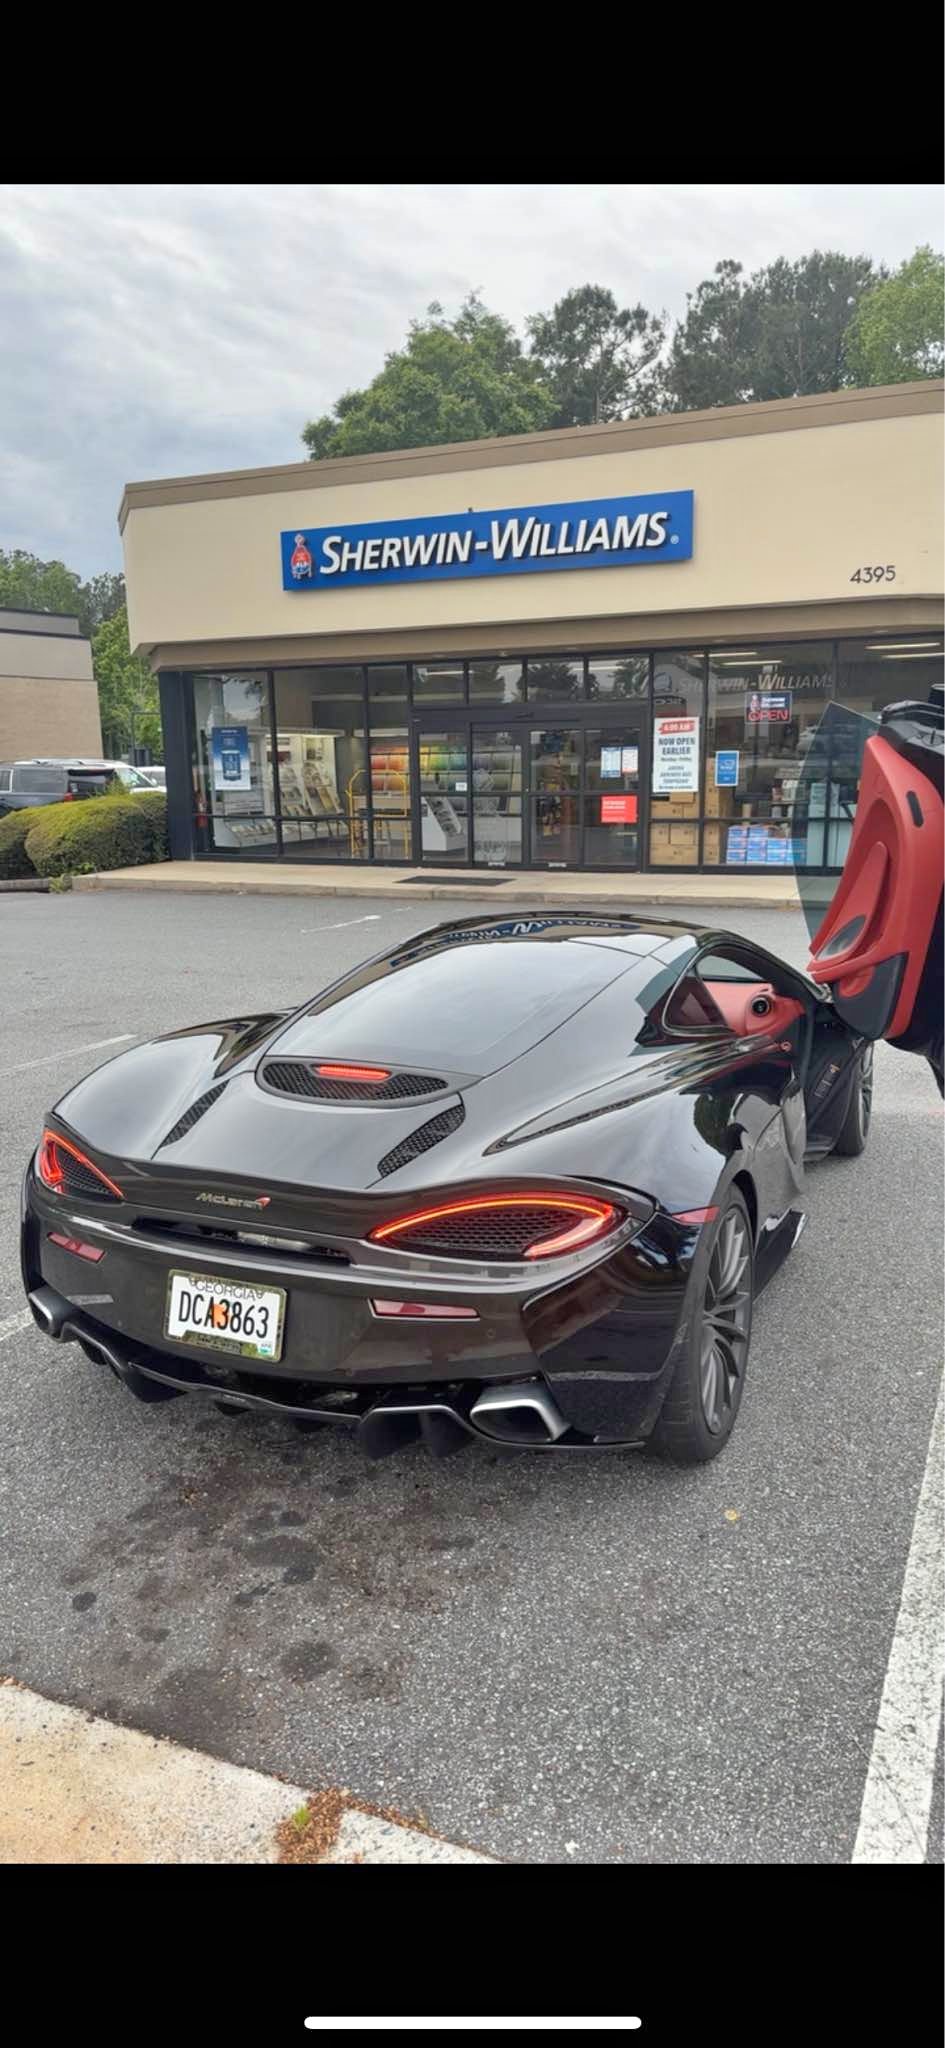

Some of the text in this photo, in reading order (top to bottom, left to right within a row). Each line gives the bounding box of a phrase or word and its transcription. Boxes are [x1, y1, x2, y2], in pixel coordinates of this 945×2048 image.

[320, 512, 667, 574] SHERWIN-WILLIAMS
[850, 565, 896, 584] 4395
[748, 709, 788, 721] OPEN
[659, 737, 696, 746] NOW OPEN
[662, 747, 691, 755] EARLIER
[196, 1279, 256, 1301] GEORGIA
[178, 1291, 269, 1338] DCA3863
